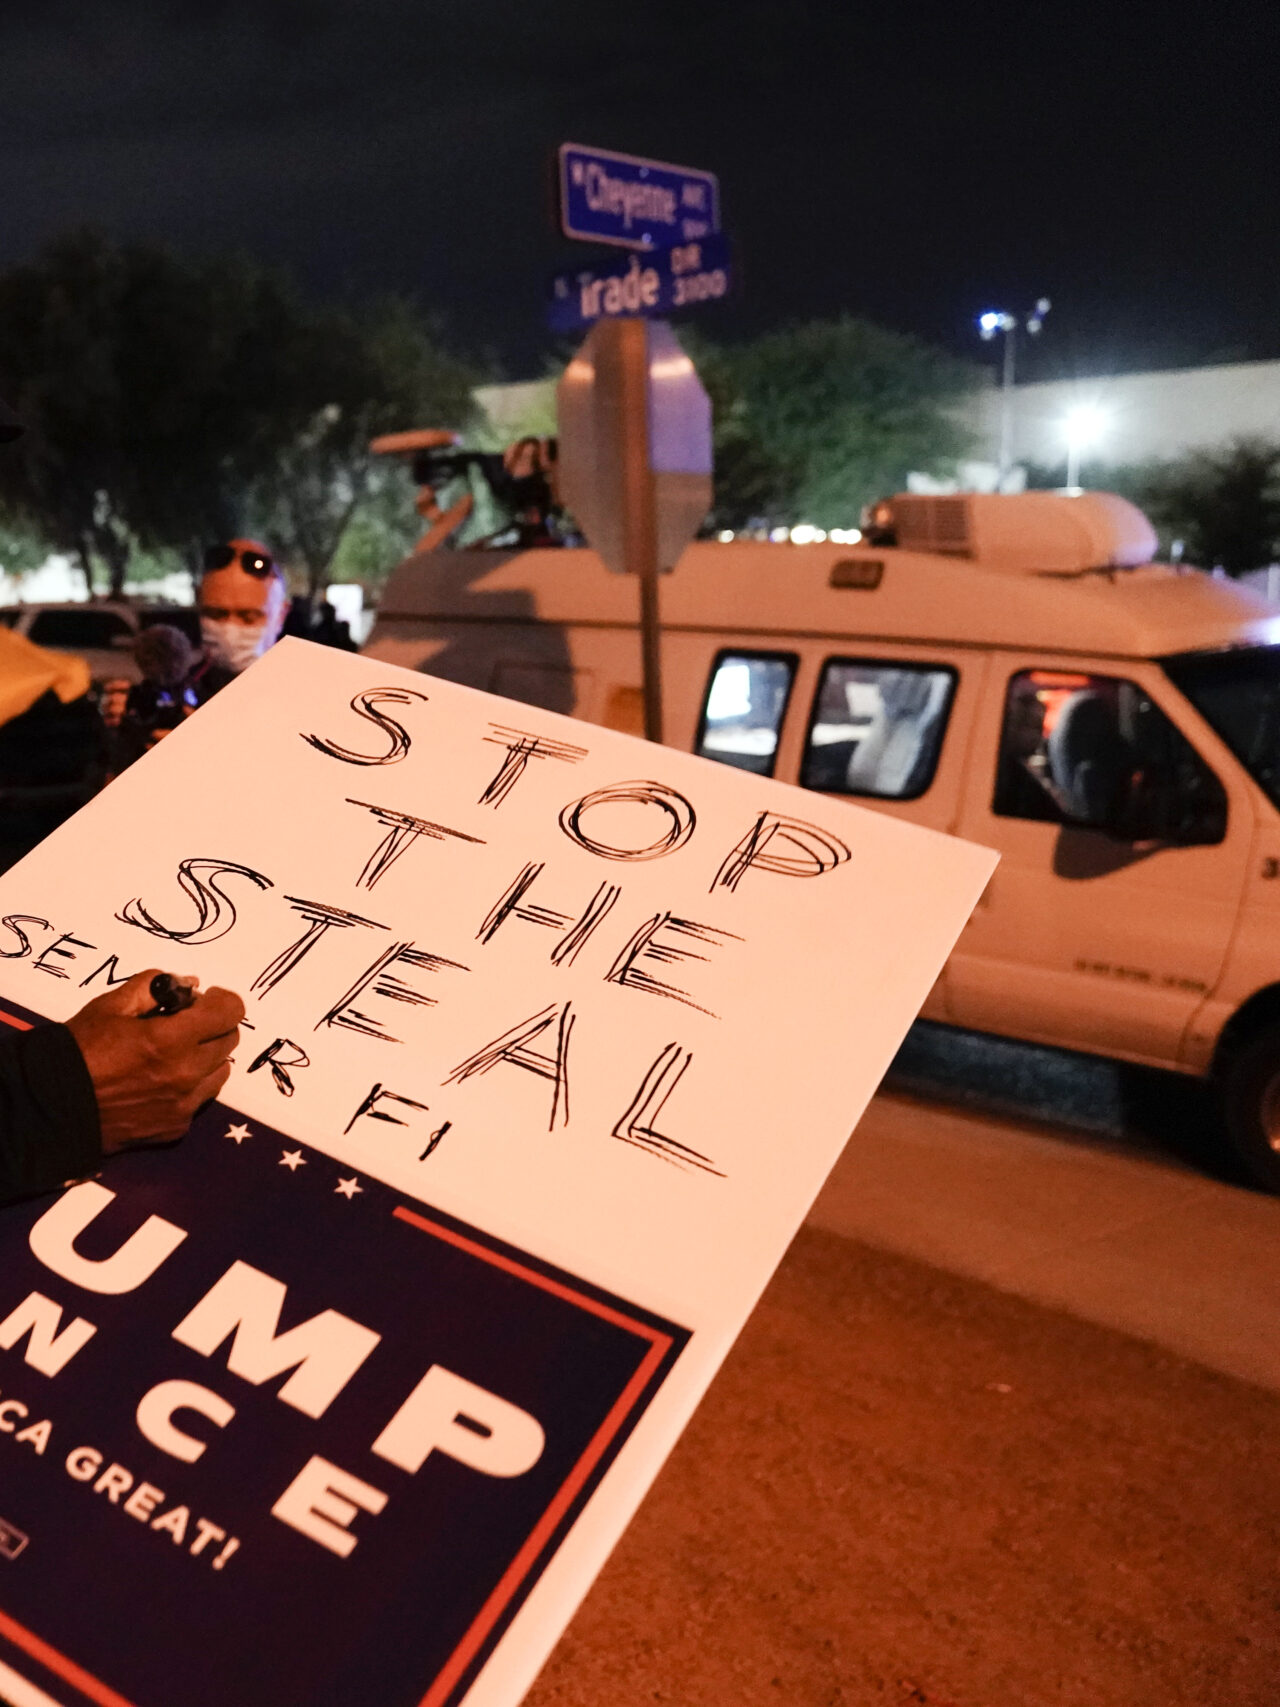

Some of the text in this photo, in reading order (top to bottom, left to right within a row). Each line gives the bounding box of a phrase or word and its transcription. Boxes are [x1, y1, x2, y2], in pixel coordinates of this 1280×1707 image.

[577, 254, 661, 318] Trade
[300, 687, 852, 893] STOP
[345, 797, 746, 1019] THE
[115, 858, 727, 1177] STEAL
[344, 1082, 453, 1162] FI
[29, 1180, 546, 1478] UMP
[66, 1447, 241, 1571] GREAT!
